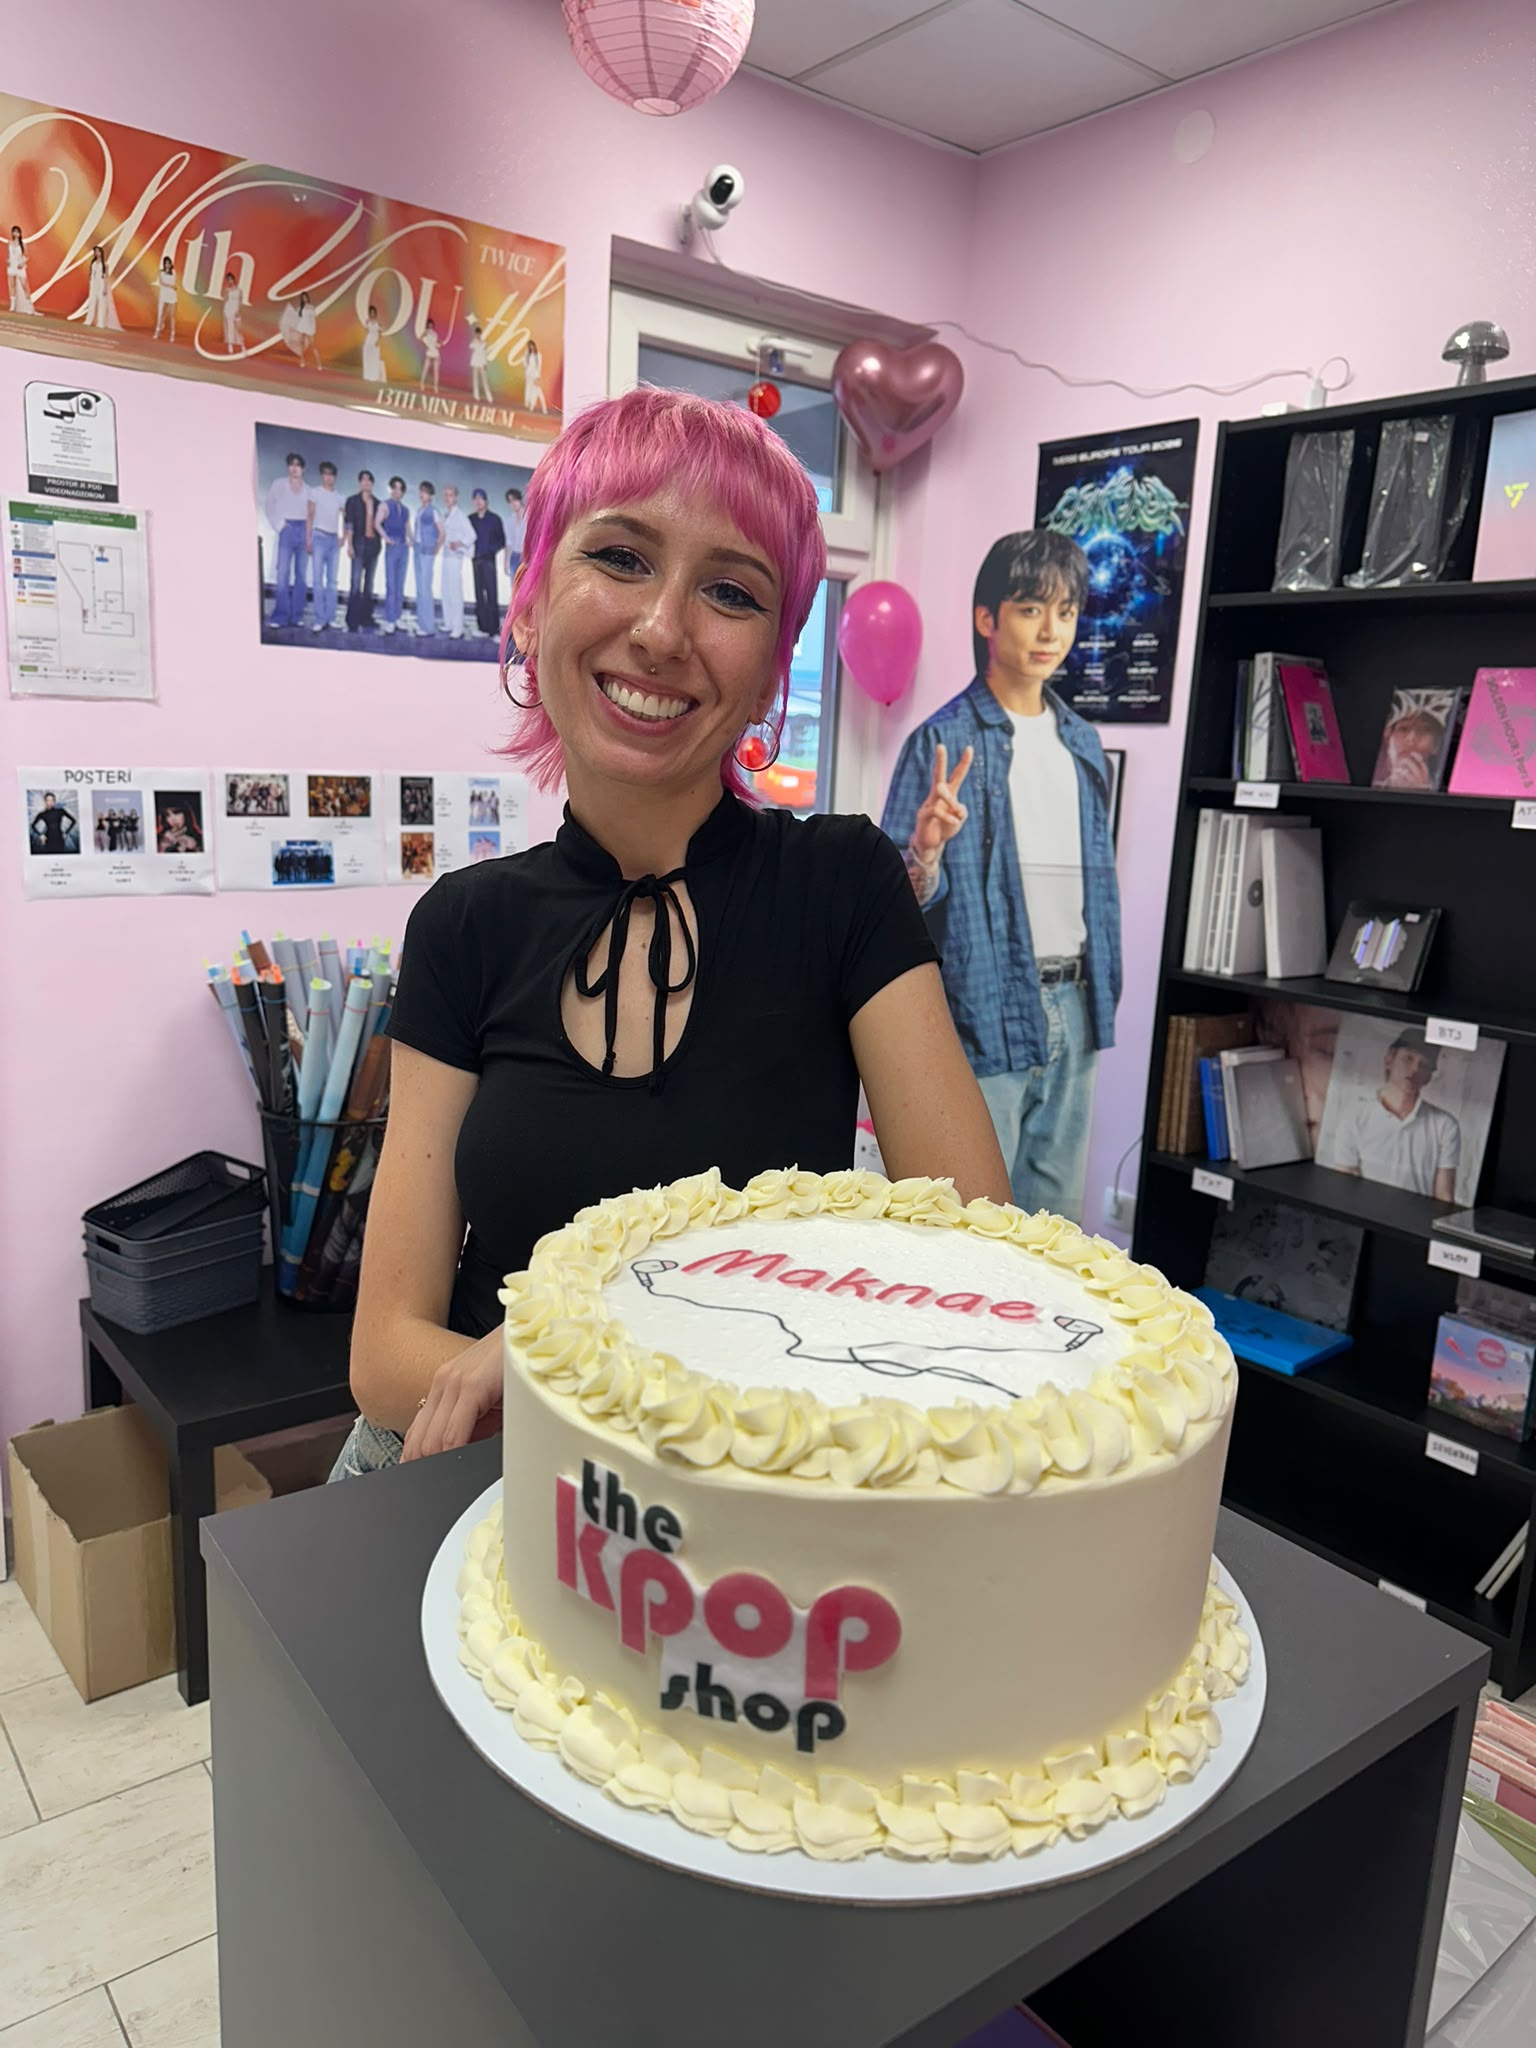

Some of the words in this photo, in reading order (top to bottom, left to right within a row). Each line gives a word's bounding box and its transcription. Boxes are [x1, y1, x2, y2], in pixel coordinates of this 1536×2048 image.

[479, 243, 537, 277] TWICE
[375, 387, 417, 411] 13TH
[419, 394, 458, 418] MINI
[458, 403, 516, 429] ALBUM
[681, 1248, 1044, 1326] Maknae
[581, 1458, 684, 1554] the
[556, 1475, 901, 1701] kpop
[660, 1662, 847, 1754] shop
